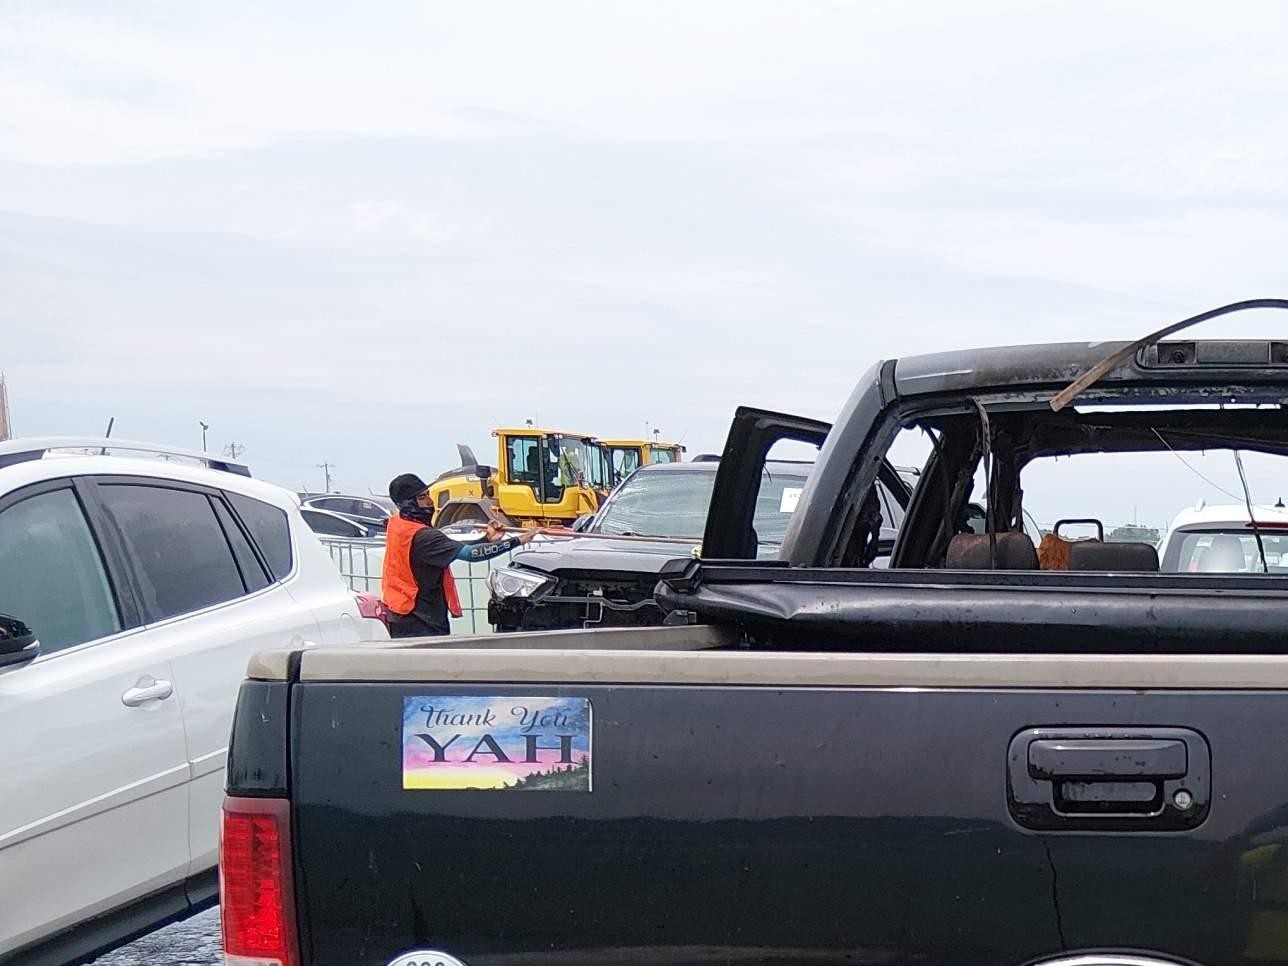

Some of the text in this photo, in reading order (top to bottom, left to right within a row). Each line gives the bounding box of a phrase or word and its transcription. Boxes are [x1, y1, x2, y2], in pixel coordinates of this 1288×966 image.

[420, 705, 569, 732] Thank You
[414, 733, 578, 764] YAH
